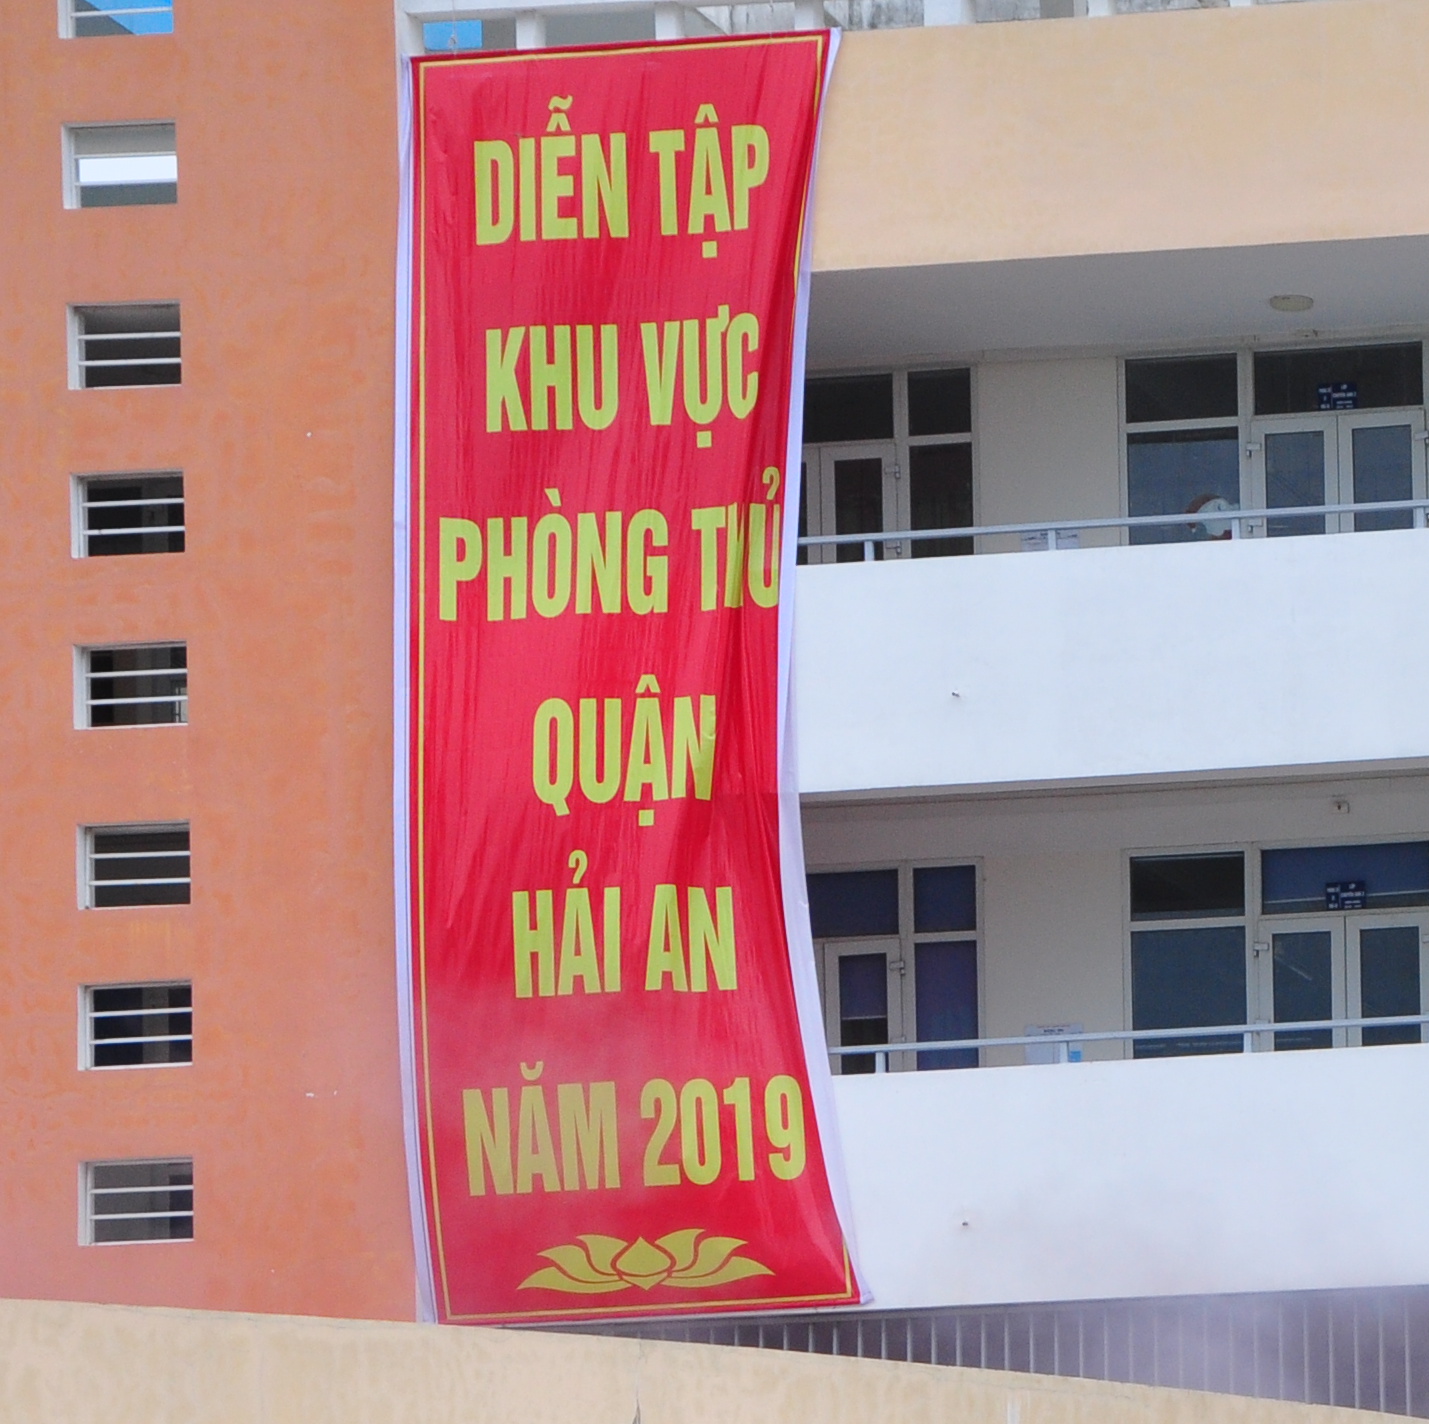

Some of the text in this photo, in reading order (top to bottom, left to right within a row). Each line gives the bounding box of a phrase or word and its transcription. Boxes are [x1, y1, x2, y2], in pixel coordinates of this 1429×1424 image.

[473, 94, 771, 259] DIỄN TẬP
[485, 303, 760, 449] KHU VỰC
[438, 488, 670, 623] PHÒNG
[532, 673, 717, 828] QUẬN
[511, 848, 738, 1000] HẢI AN
[462, 1060, 807, 1198] NĂM 2019
